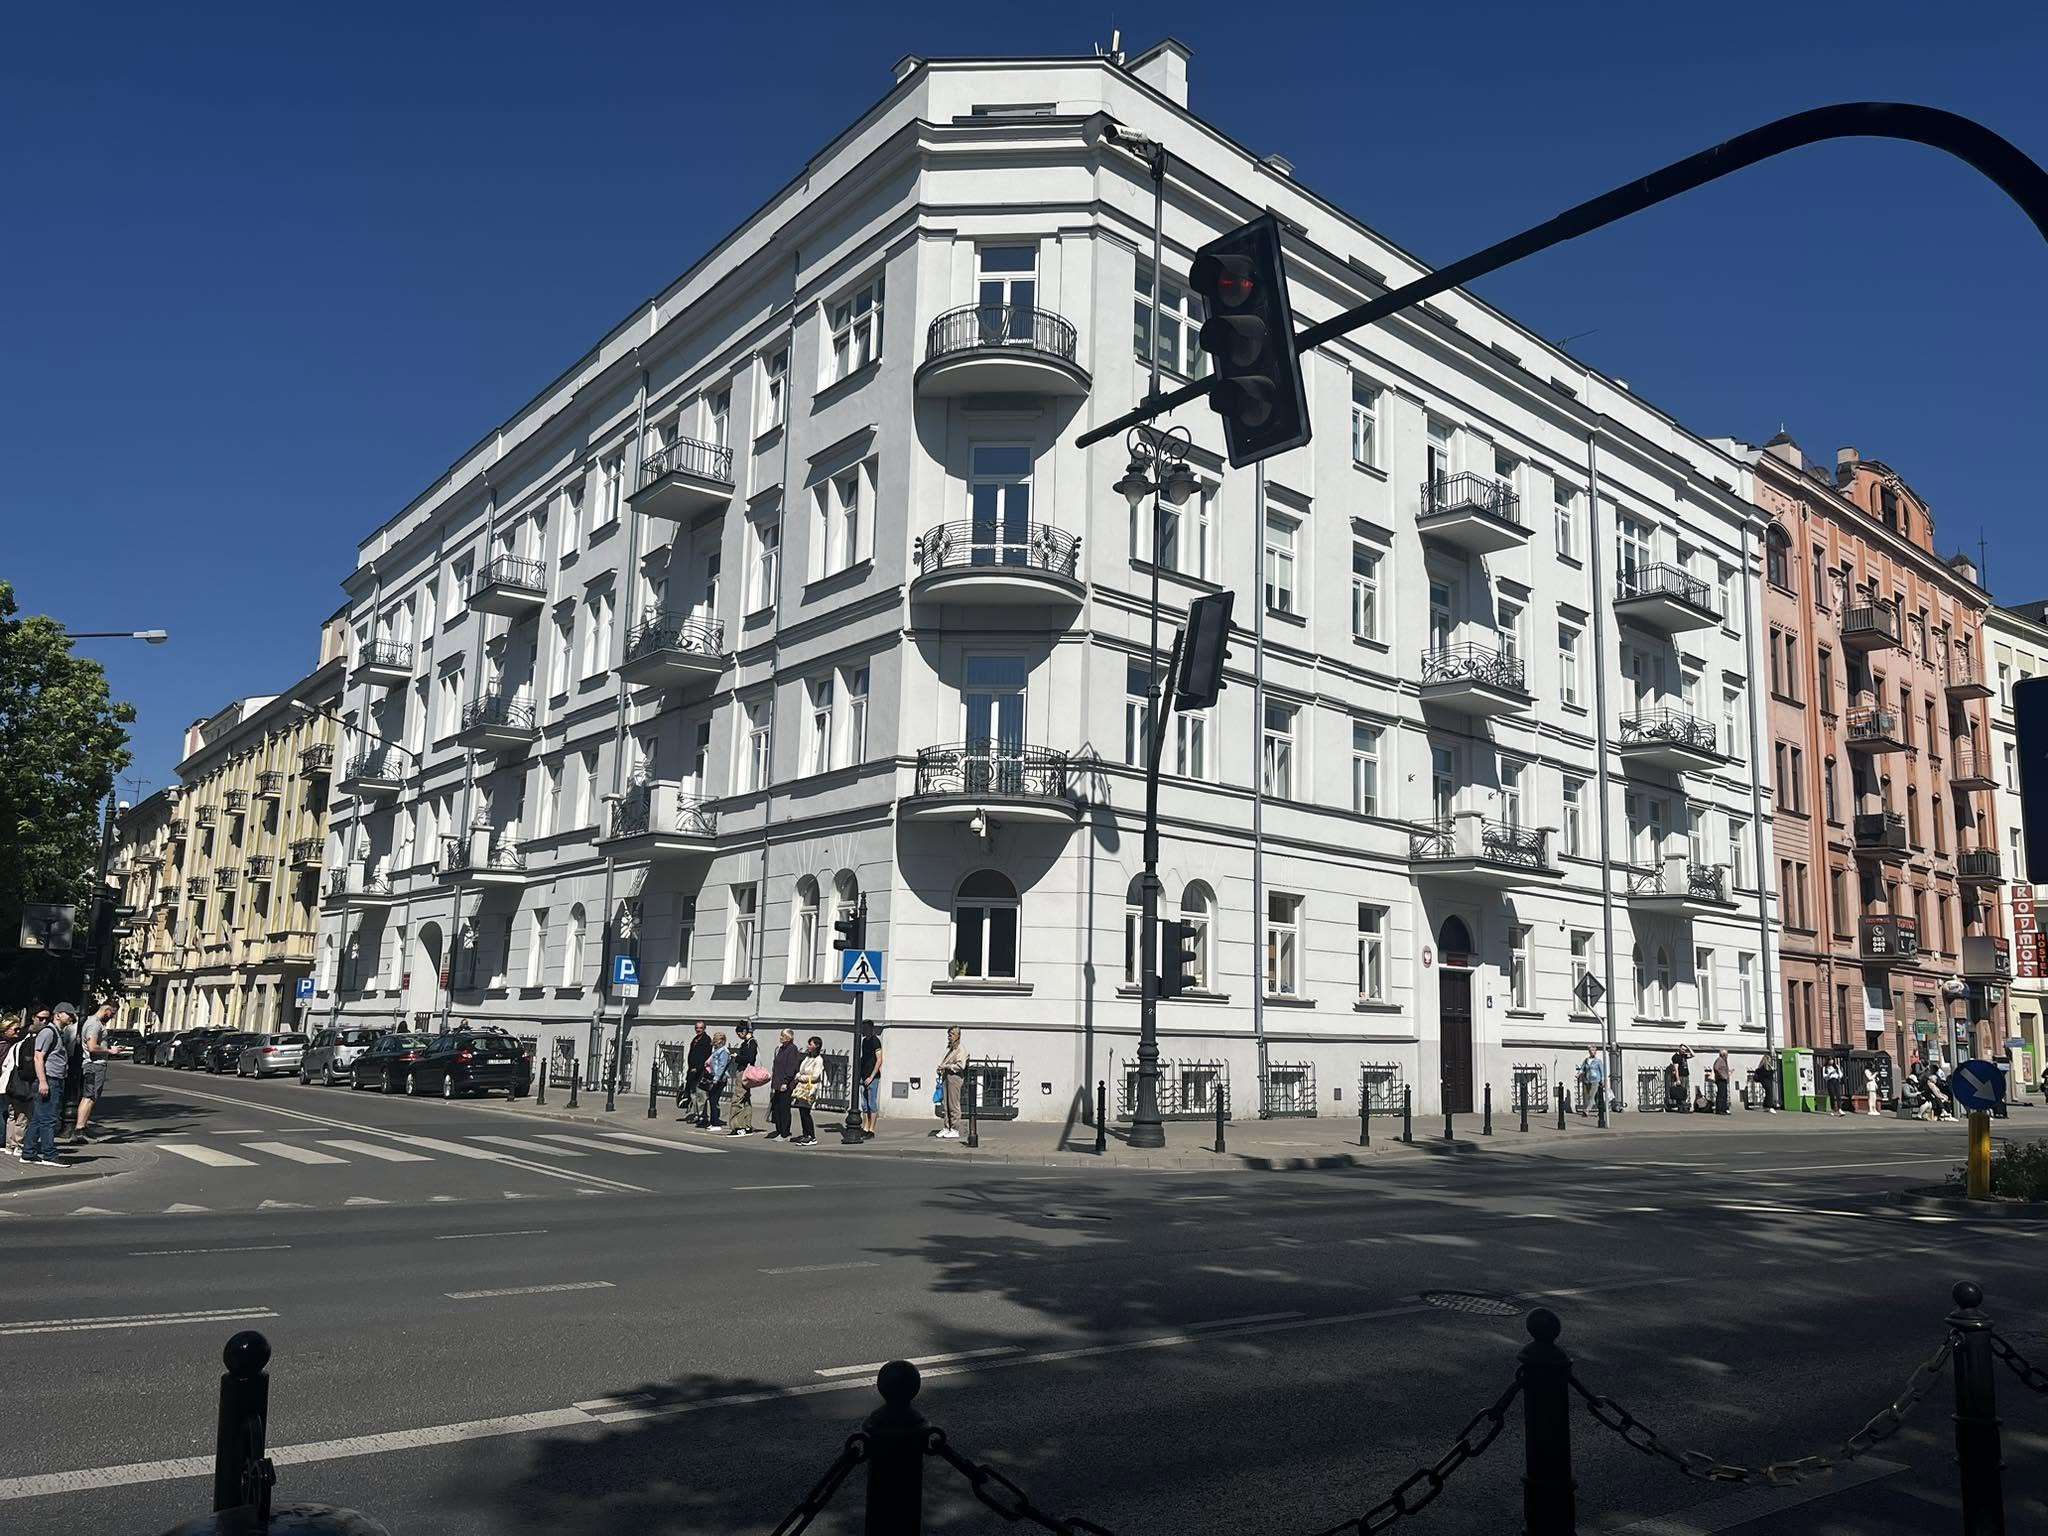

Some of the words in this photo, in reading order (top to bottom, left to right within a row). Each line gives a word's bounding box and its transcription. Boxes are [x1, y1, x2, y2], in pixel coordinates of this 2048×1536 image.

[2037, 933, 2048, 977] HOSTEL
[620, 959, 635, 979] P
[301, 979, 311, 993] P
